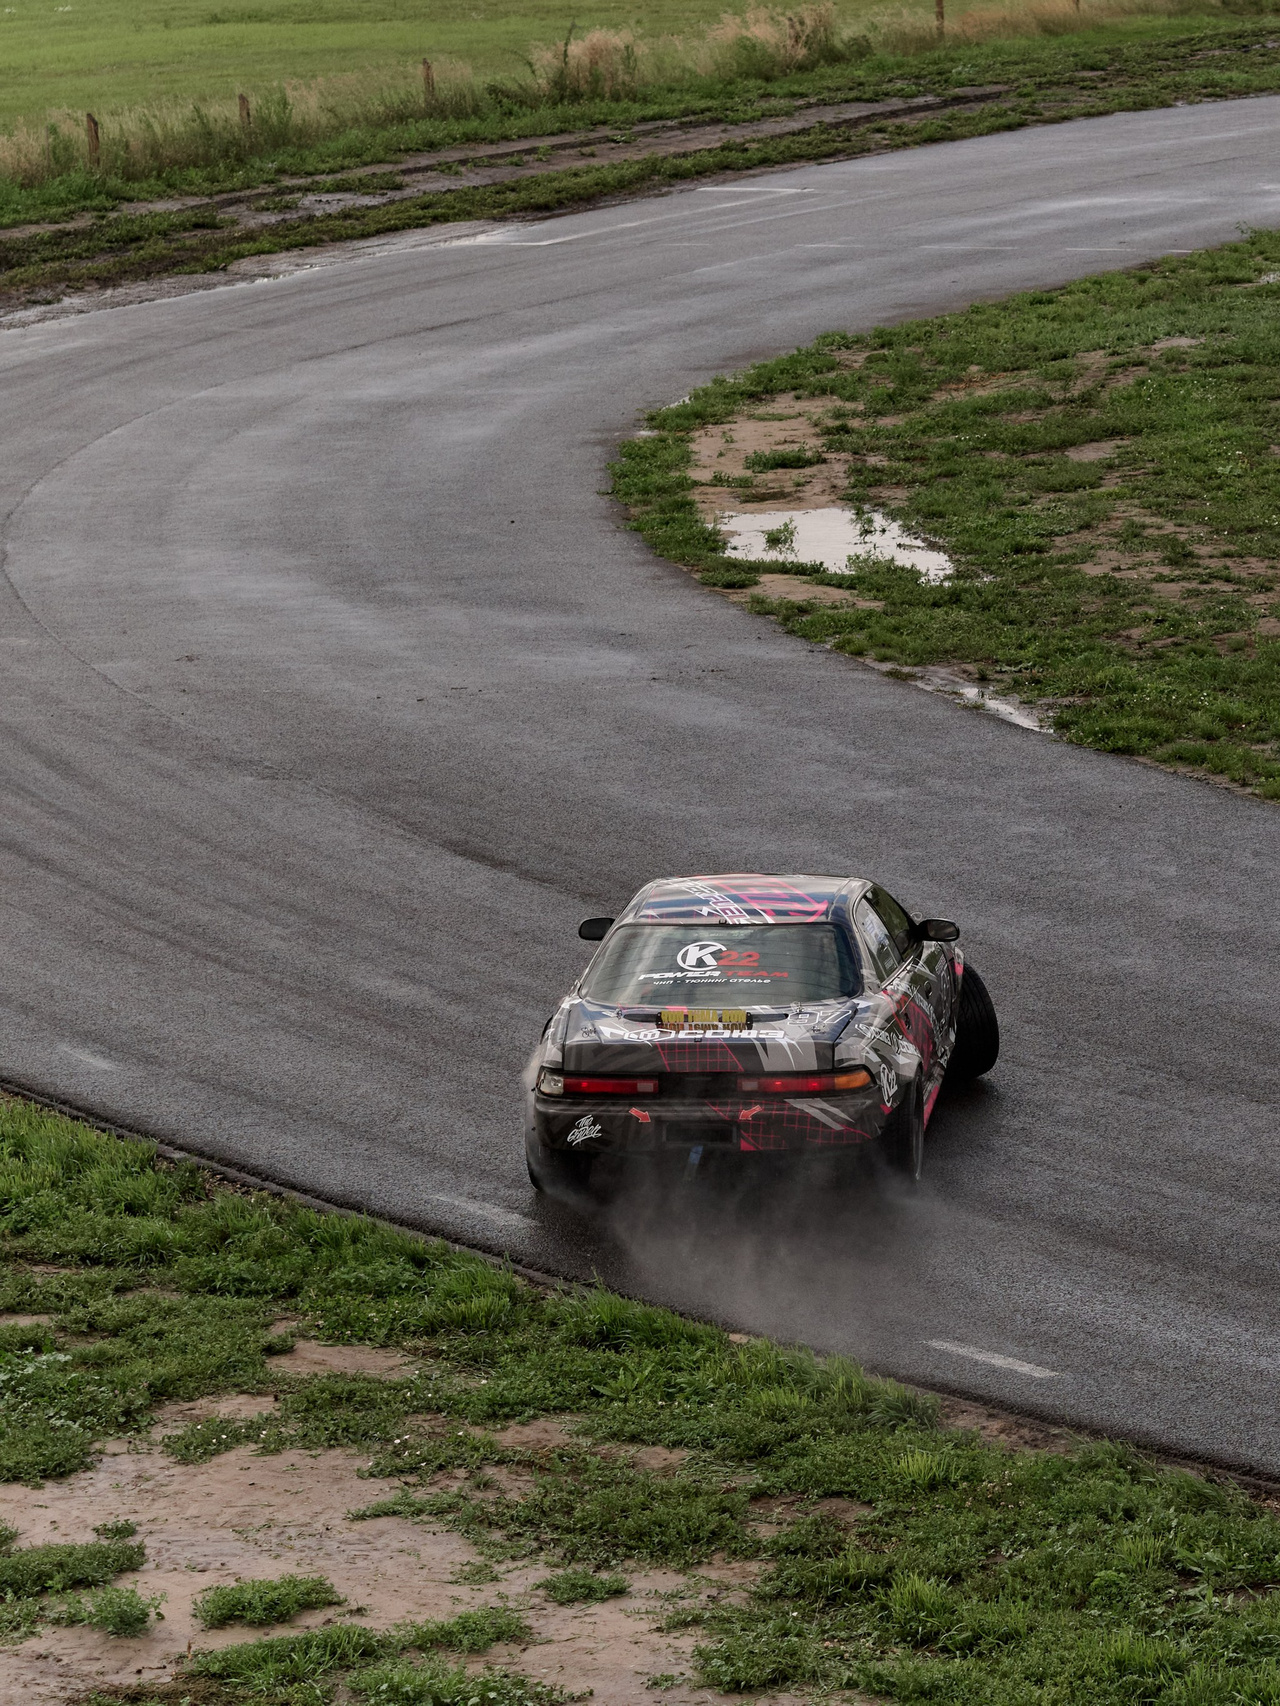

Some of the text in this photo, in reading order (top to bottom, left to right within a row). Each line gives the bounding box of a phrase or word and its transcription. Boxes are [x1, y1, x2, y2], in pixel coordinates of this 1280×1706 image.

[681, 944, 760, 968] K22
[638, 971, 789, 980] POWER TEAM
